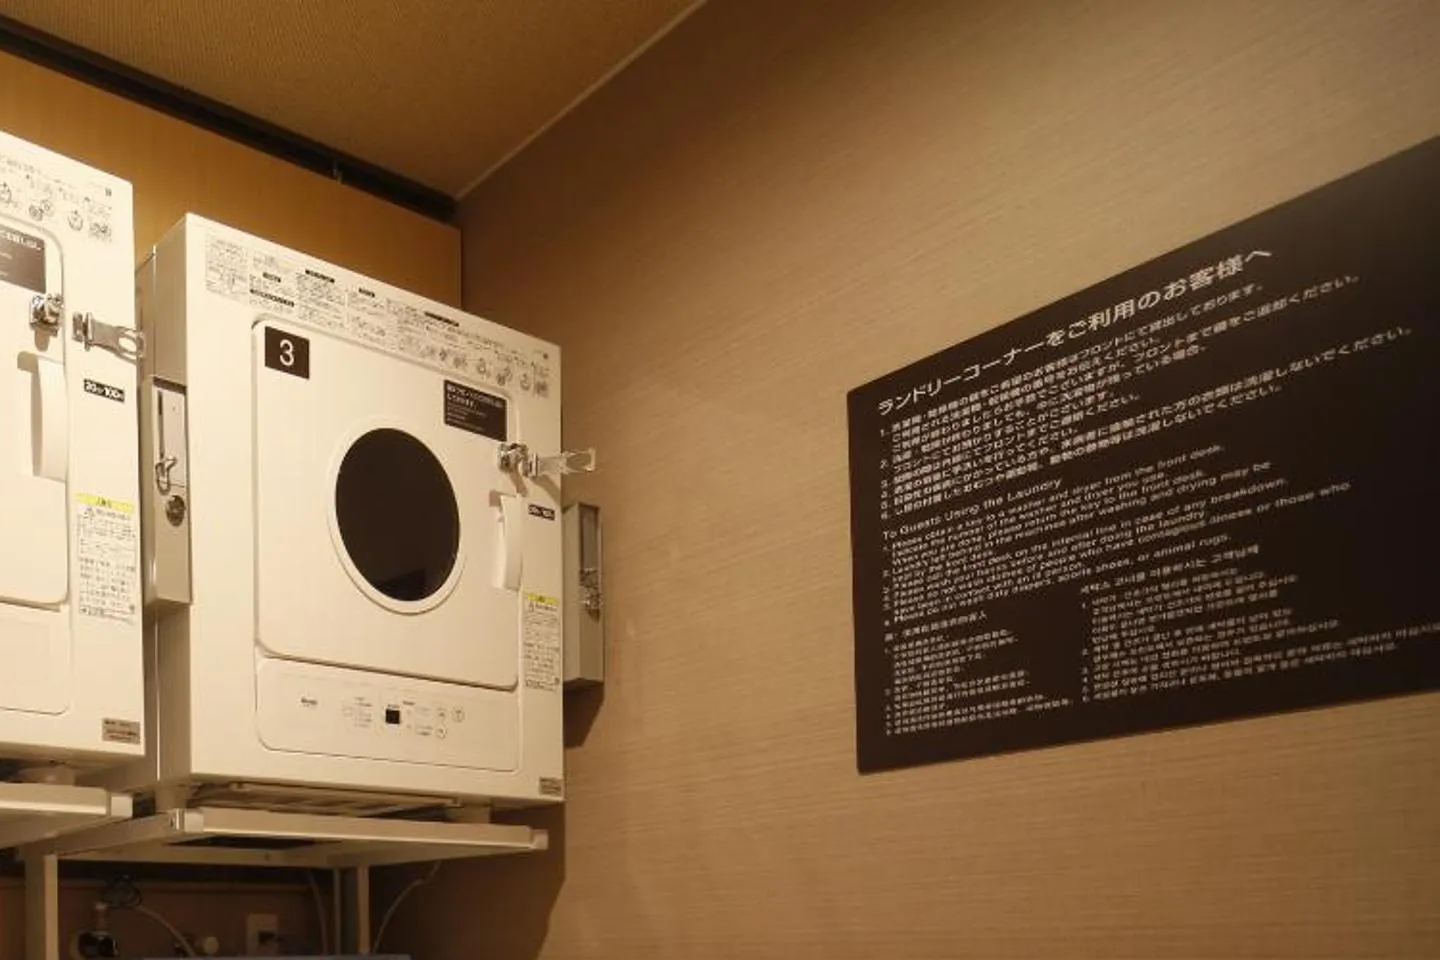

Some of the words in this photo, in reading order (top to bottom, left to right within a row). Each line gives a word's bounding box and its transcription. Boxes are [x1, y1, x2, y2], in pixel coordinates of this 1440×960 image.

[279, 338, 295, 367] 3
[878, 247, 1274, 416] ランドリーコーナーをご利用のお客様へ
